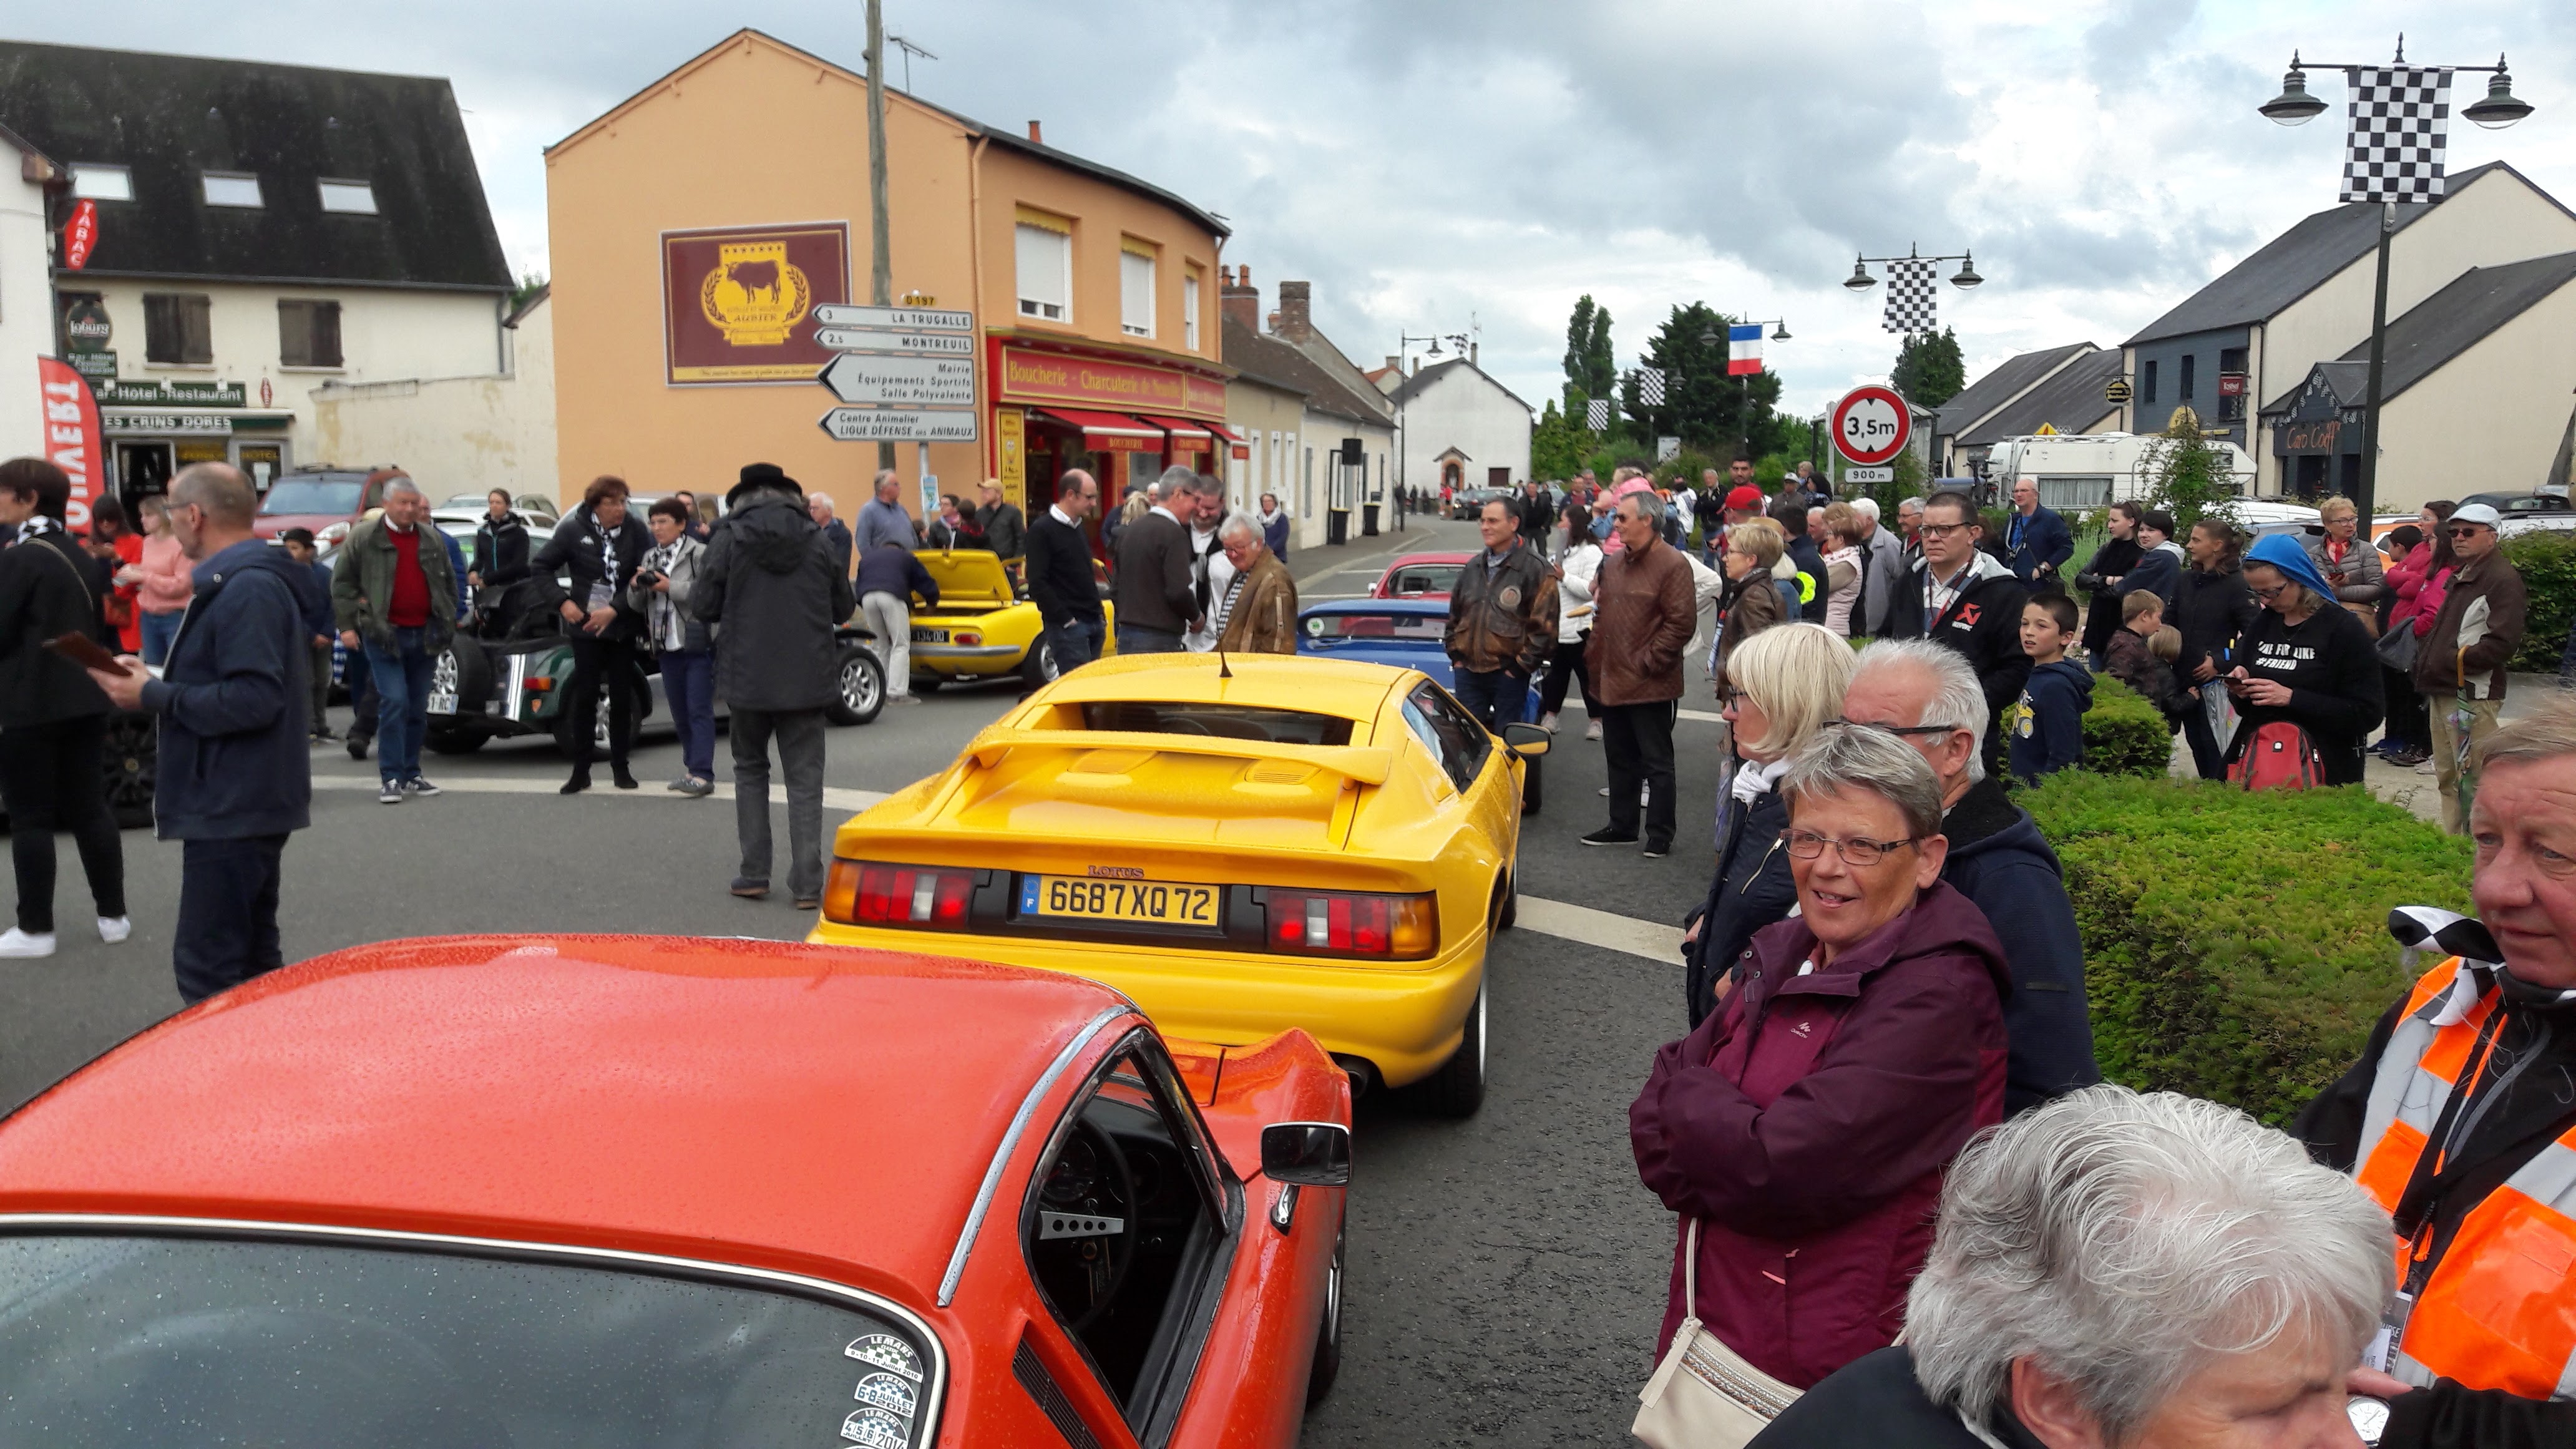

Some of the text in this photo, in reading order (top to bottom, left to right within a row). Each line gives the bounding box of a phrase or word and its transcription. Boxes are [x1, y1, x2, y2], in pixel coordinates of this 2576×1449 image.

[71, 201, 94, 266] TABAC
[827, 310, 968, 326] 3 LA TRUGALLE
[902, 337, 969, 350] MONTREUIL
[938, 363, 970, 374] Mairie
[1009, 360, 1068, 387] Boucherie
[858, 372, 971, 388] Équipements Sportifs
[95, 387, 109, 401] ar
[118, 386, 157, 401] Hotel
[167, 385, 242, 402] Restaurant
[881, 388, 971, 401] Salle Polyvalente
[104, 415, 123, 427] ES
[129, 415, 175, 428] CRINS
[840, 412, 919, 424] Centre Animalier
[840, 424, 868, 435] LIGUE
[872, 424, 912, 436] DÉFENSE
[930, 426, 973, 437] ANIMAUX
[1847, 416, 1895, 439] 3,5m
[1109, 437, 1143, 449] BOUCHERIE
[1853, 471, 1875, 479] 900
[2293, 646, 2316, 660] LIKE
[2255, 657, 2297, 671] #FRIEND
[1088, 865, 1144, 879] LOTUS
[1027, 897, 1035, 908] F
[871, 1336, 913, 1359] LE MANS
[881, 1359, 901, 1373] Juillet
[903, 1369, 919, 1379] 2010
[886, 1375, 907, 1391] MANS
[876, 1398, 912, 1416] 2012
[877, 1392, 914, 1409] JUILLET
[875, 1410, 899, 1428] MANS
[842, 1432, 872, 1443] JUILLET
